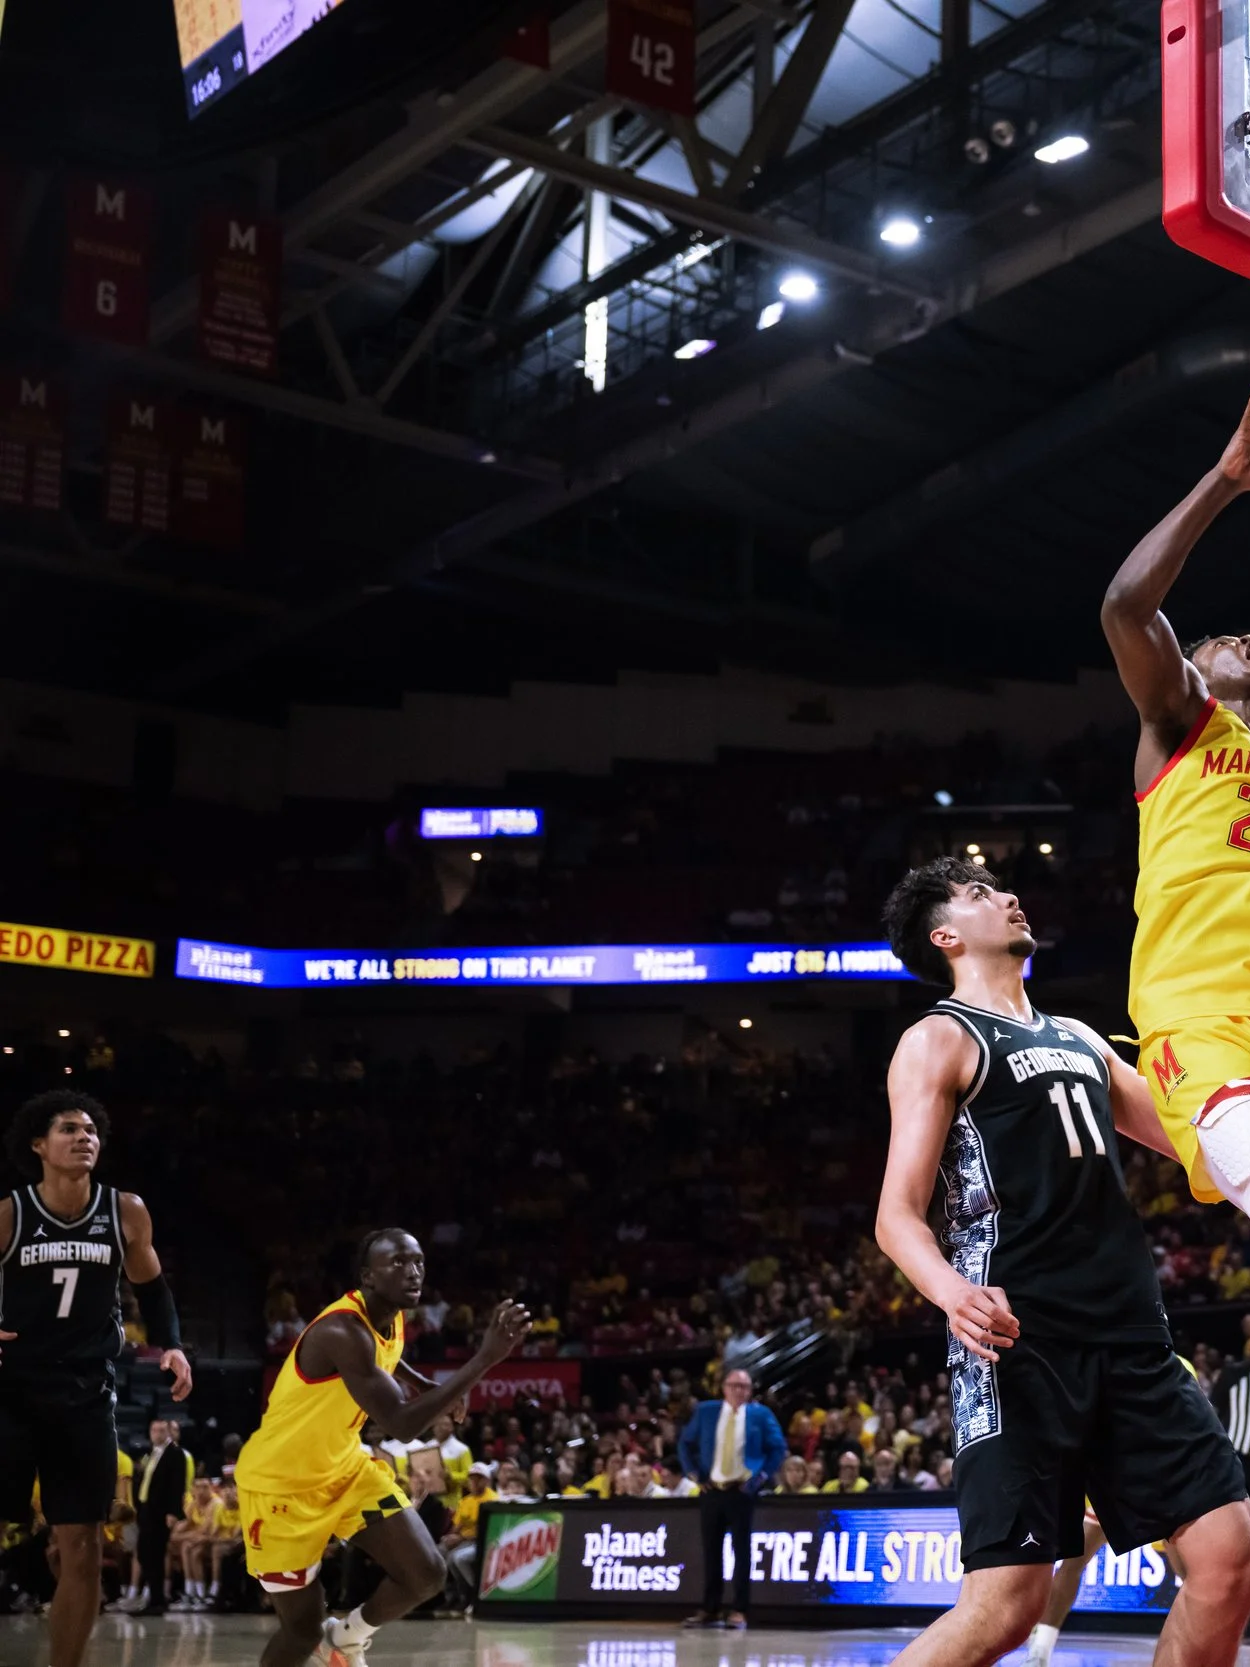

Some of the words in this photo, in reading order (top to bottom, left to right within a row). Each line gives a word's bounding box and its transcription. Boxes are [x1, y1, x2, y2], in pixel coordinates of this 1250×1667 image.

[629, 33, 676, 87] 42
[95, 183, 126, 221] M
[228, 220, 257, 255] M
[96, 280, 117, 316] 6
[20, 376, 46, 409] M
[130, 400, 155, 431] M
[201, 416, 226, 445] M
[0, 929, 54, 960] EDO
[65, 935, 149, 973] PIZZA
[190, 944, 252, 968] planet
[358, 959, 392, 981] ALL
[461, 957, 488, 979] ON
[489, 956, 528, 979] THIS
[529, 956, 596, 978] PLANET
[747, 951, 793, 974] JUST
[1006, 1046, 1103, 1084] GEORGETOWN
[1048, 1081, 1106, 1159] 11
[20, 1240, 112, 1267] GEORGETOWN
[52, 1267, 80, 1319] 7
[479, 1378, 566, 1398] TOYOTA
[581, 1523, 668, 1567] planet
[814, 1531, 874, 1582] ALL
[881, 1530, 964, 1583] STRO
[590, 1556, 681, 1592] fitness
